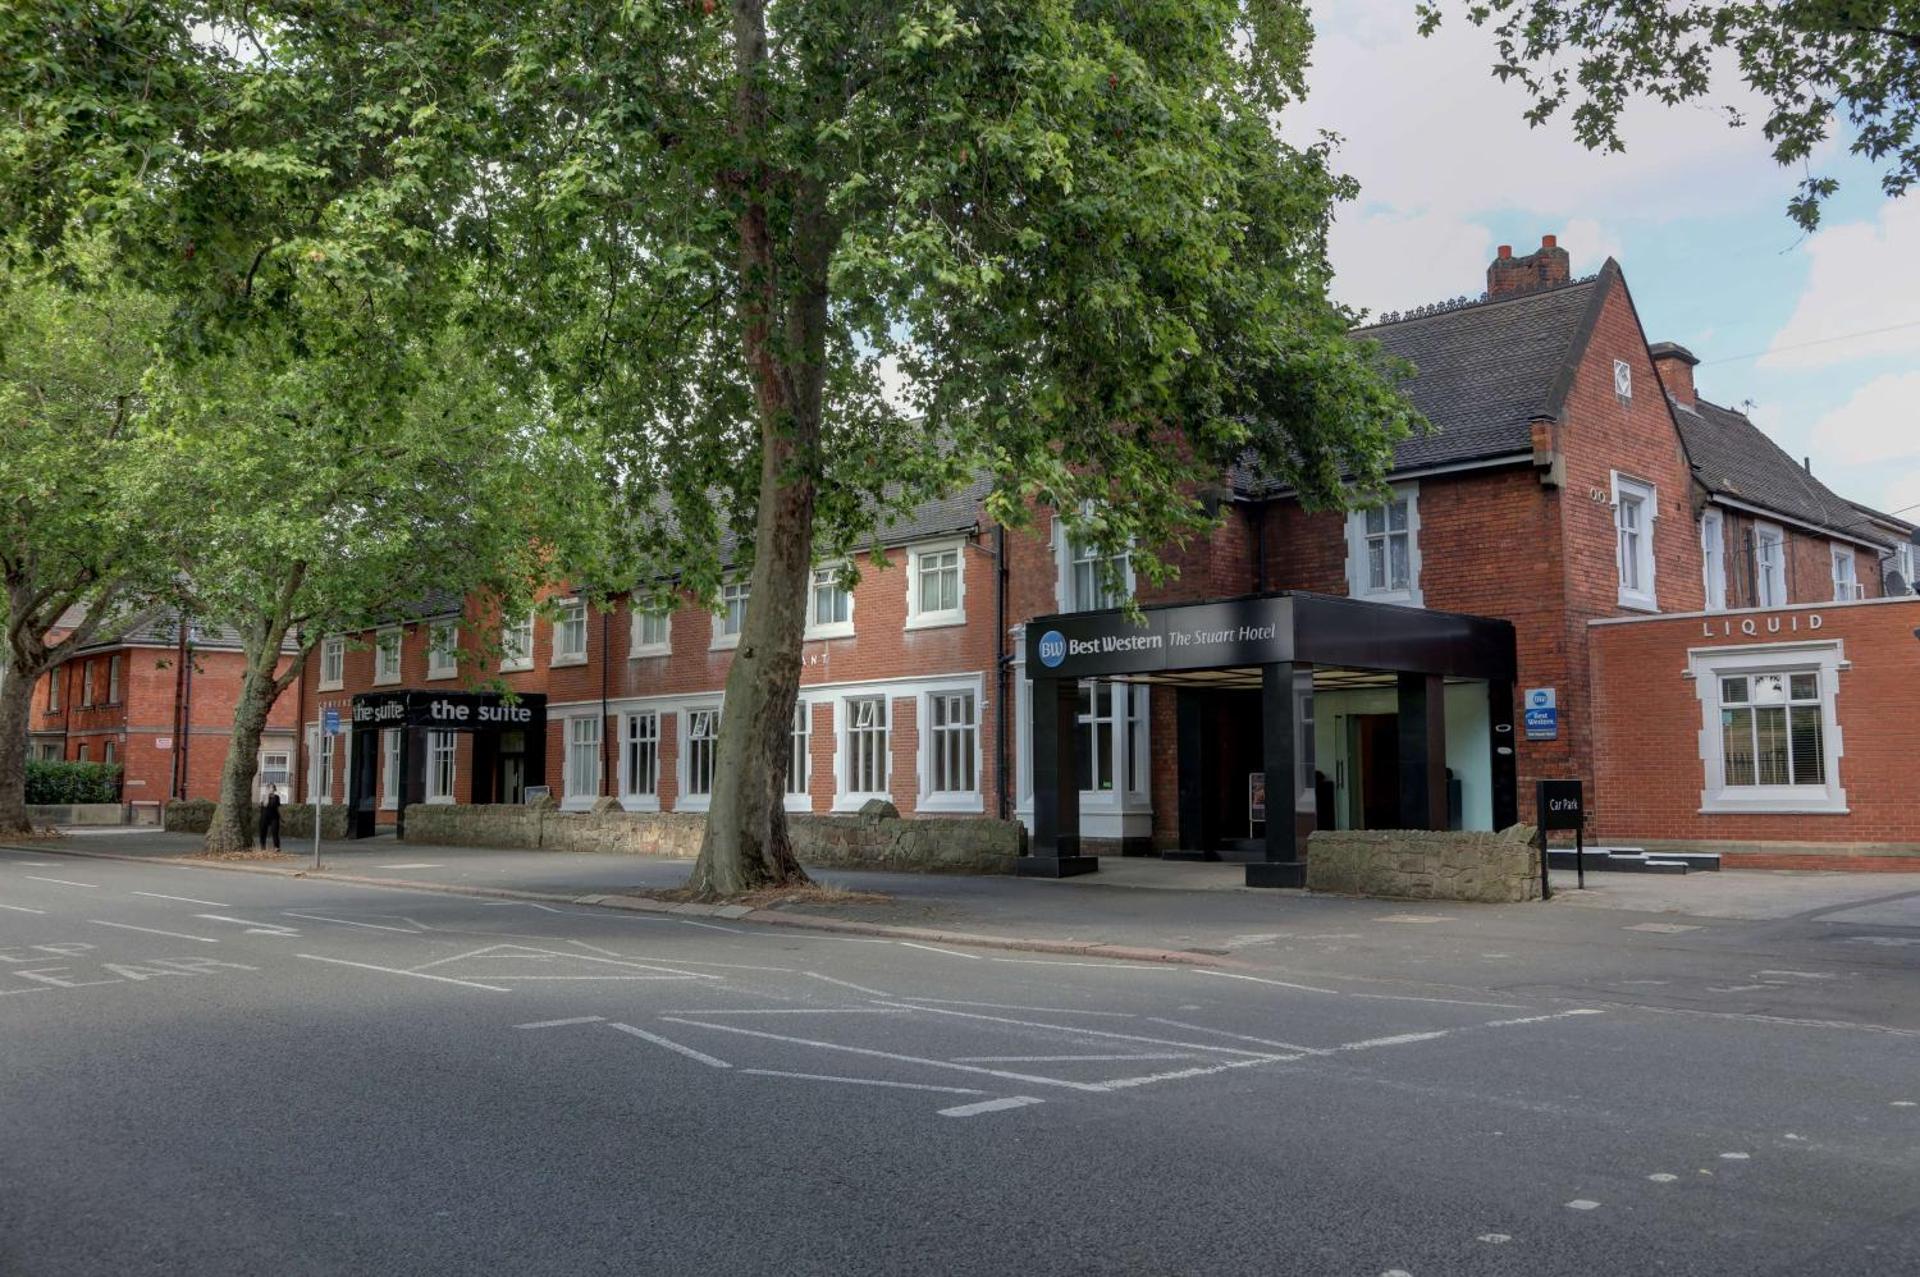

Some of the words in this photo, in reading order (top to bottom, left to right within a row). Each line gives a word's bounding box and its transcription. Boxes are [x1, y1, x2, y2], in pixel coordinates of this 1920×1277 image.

[1703, 614, 1822, 637] LIQUID
[1042, 641, 1063, 658] BW
[1069, 639, 1100, 655] Best
[1102, 635, 1162, 653] Western
[1168, 631, 1191, 646] The
[1193, 629, 1235, 645] Stuart
[1239, 623, 1275, 641] Hotel
[353, 698, 374, 722] the
[374, 700, 405, 722] suite
[430, 700, 470, 720] the
[477, 703, 532, 722] suite
[1550, 798, 1562, 811] Car
[1562, 798, 1578, 810] Park
